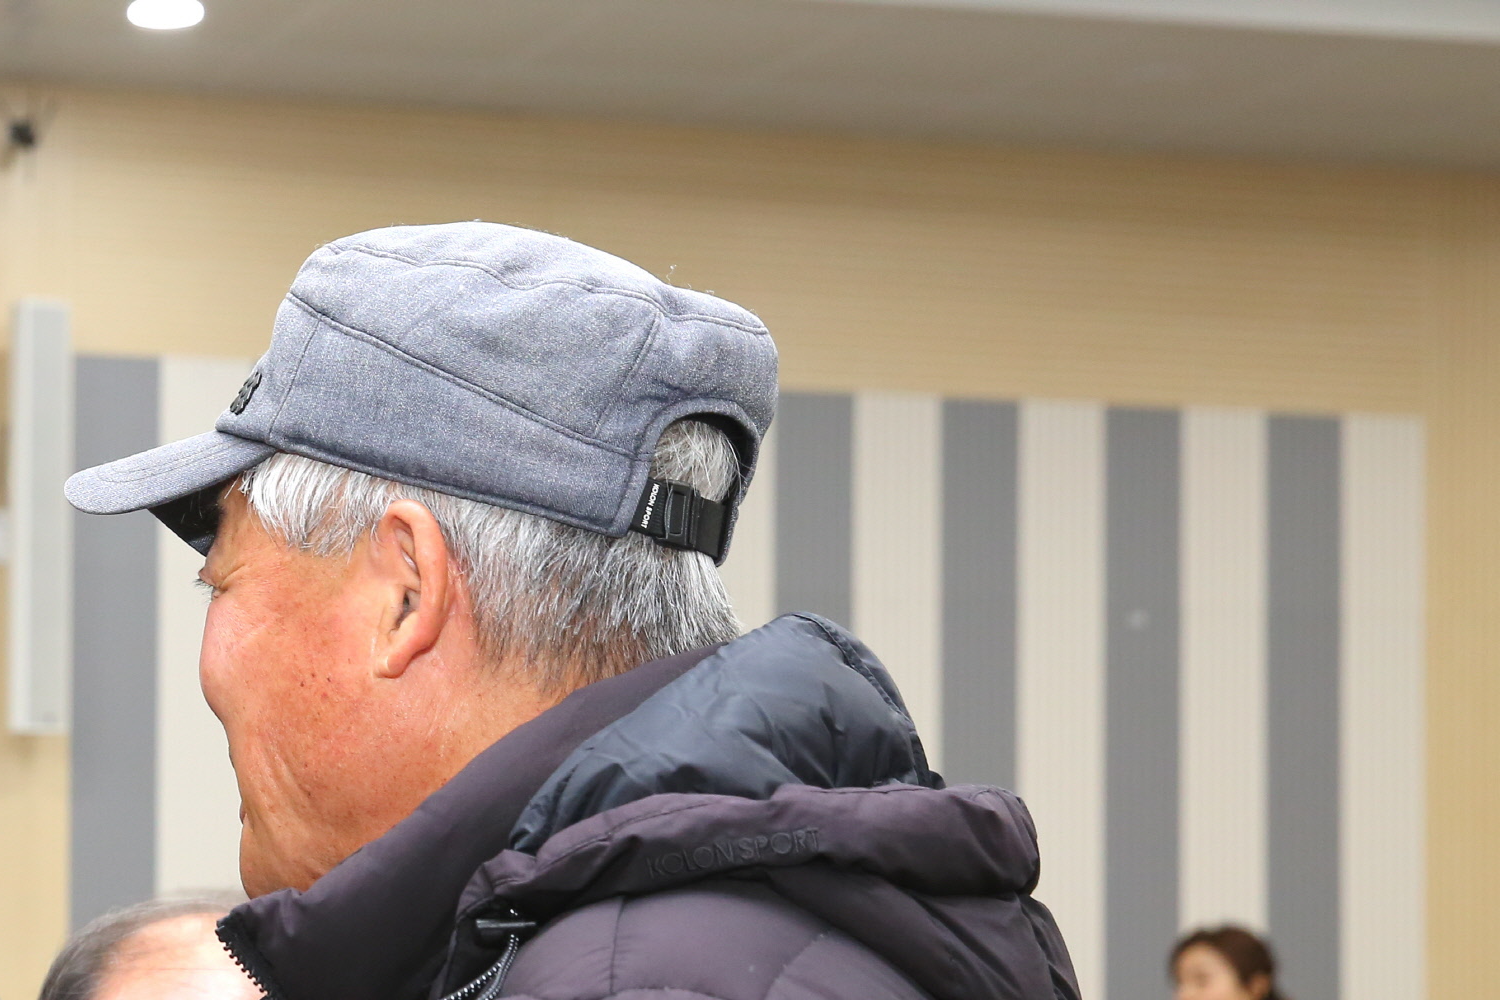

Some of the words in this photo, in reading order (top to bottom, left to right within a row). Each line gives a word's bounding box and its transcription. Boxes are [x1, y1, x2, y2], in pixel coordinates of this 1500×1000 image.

[647, 483, 660, 506] KOLON
[641, 506, 653, 529] SPORT
[646, 840, 734, 877] KOLON
[739, 827, 819, 859] SPORT
